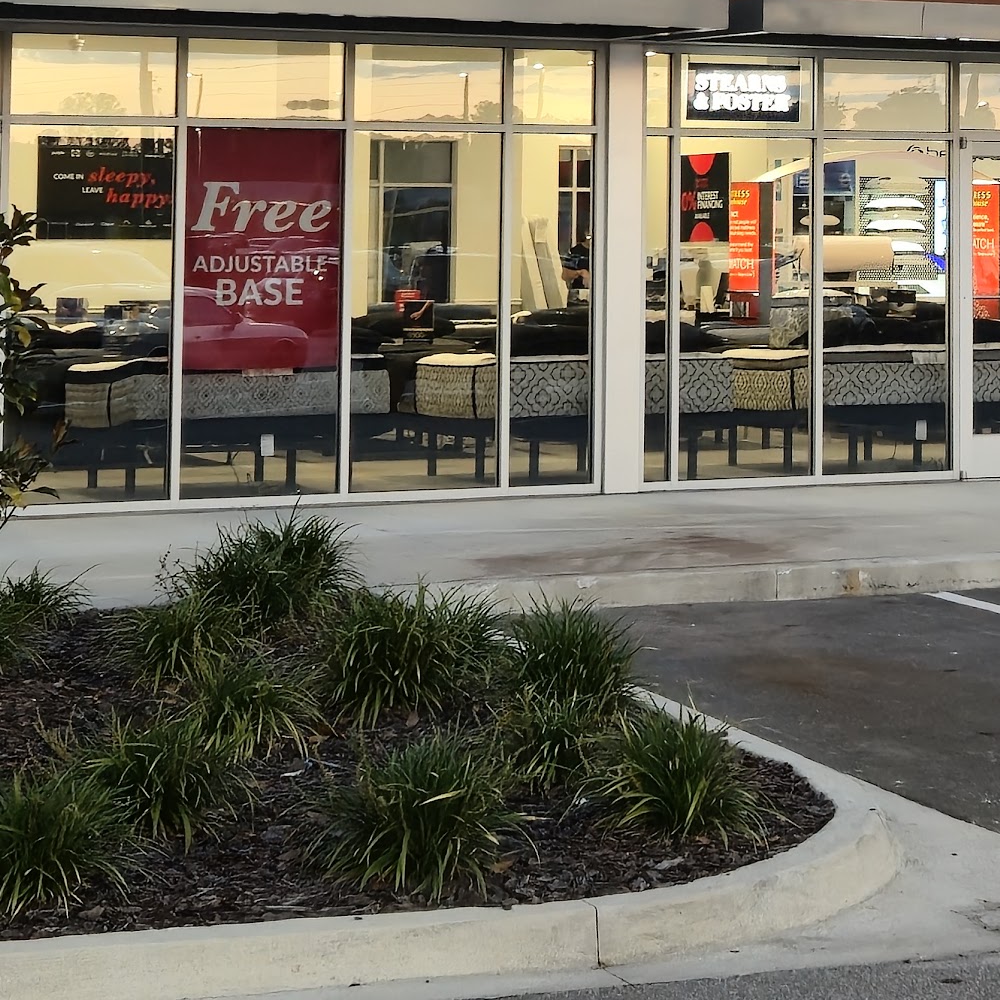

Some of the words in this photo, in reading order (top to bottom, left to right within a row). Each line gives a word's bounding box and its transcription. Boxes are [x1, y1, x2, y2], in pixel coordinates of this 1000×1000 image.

[695, 73, 787, 93] STEARNS
[693, 92, 710, 111] &
[712, 92, 791, 112] FOSTER
[87, 166, 156, 188] sleepy,
[190, 181, 332, 232] Free
[192, 255, 328, 273] ADJUSTABLE
[216, 278, 304, 306] BASE
